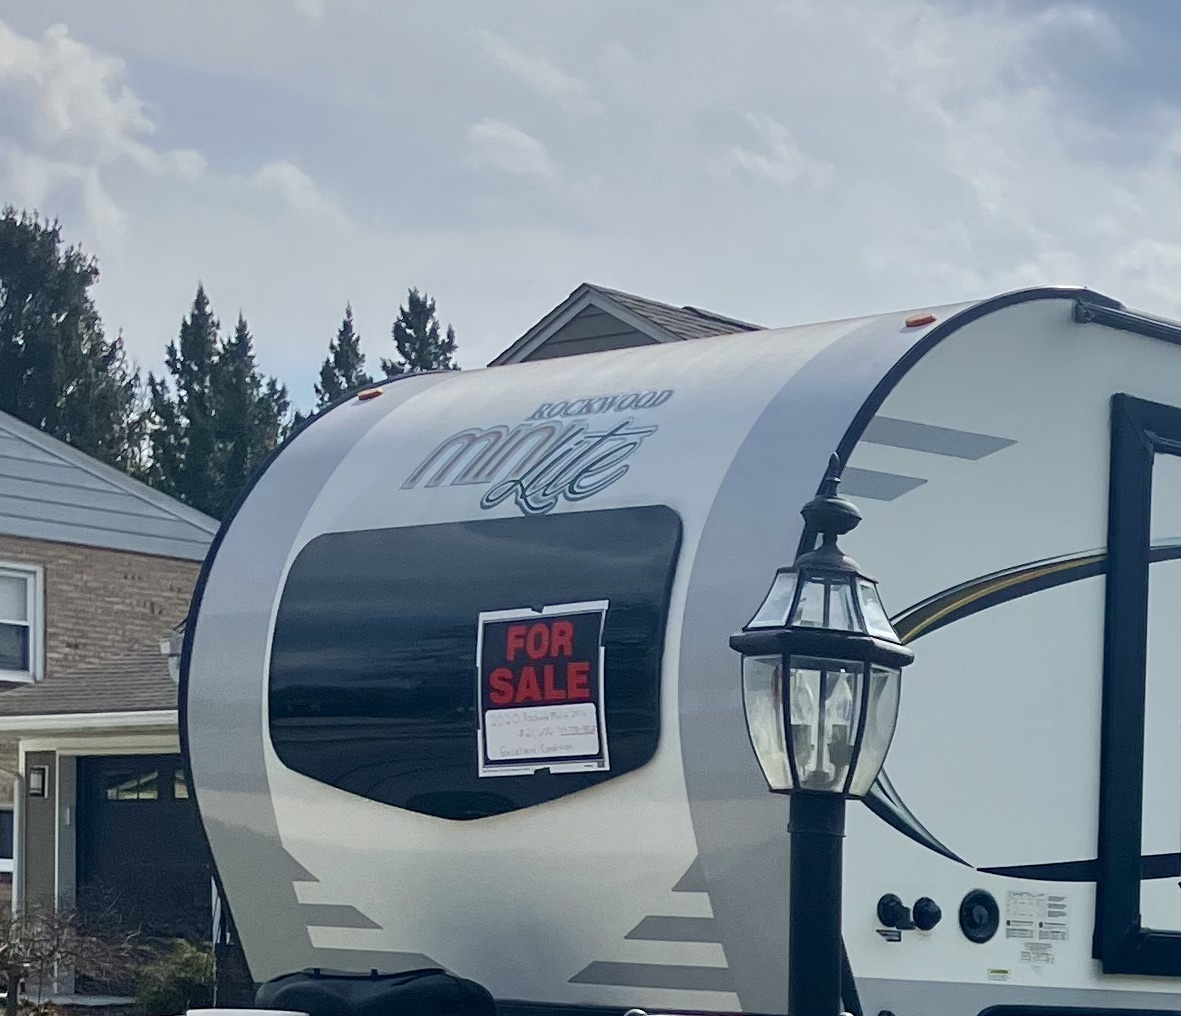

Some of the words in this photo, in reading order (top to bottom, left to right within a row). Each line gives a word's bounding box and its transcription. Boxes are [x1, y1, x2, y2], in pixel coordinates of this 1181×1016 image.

[525, 389, 675, 421] ROCKWOOD
[505, 619, 574, 662] FOR
[489, 662, 591, 705] SALE
